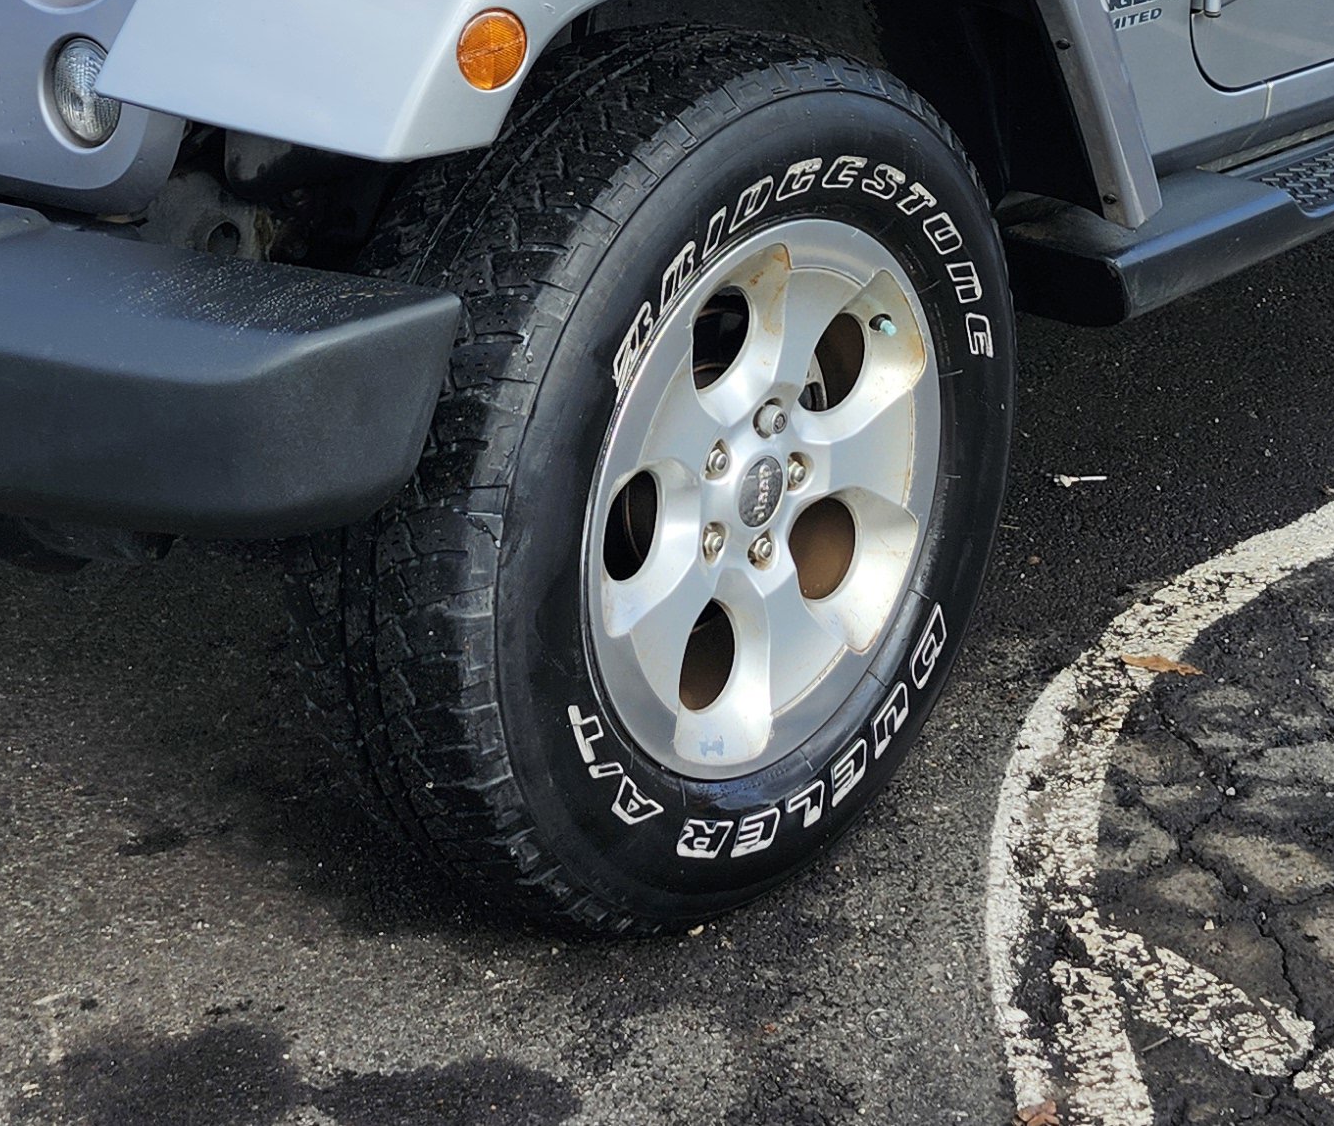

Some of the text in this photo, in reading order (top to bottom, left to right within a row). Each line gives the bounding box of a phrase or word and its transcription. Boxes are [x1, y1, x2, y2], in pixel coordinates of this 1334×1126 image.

[1114, 8, 1162, 30] ITED
[612, 155, 994, 388] BRIDGESTONE
[568, 602, 948, 860] DUELER A/T
